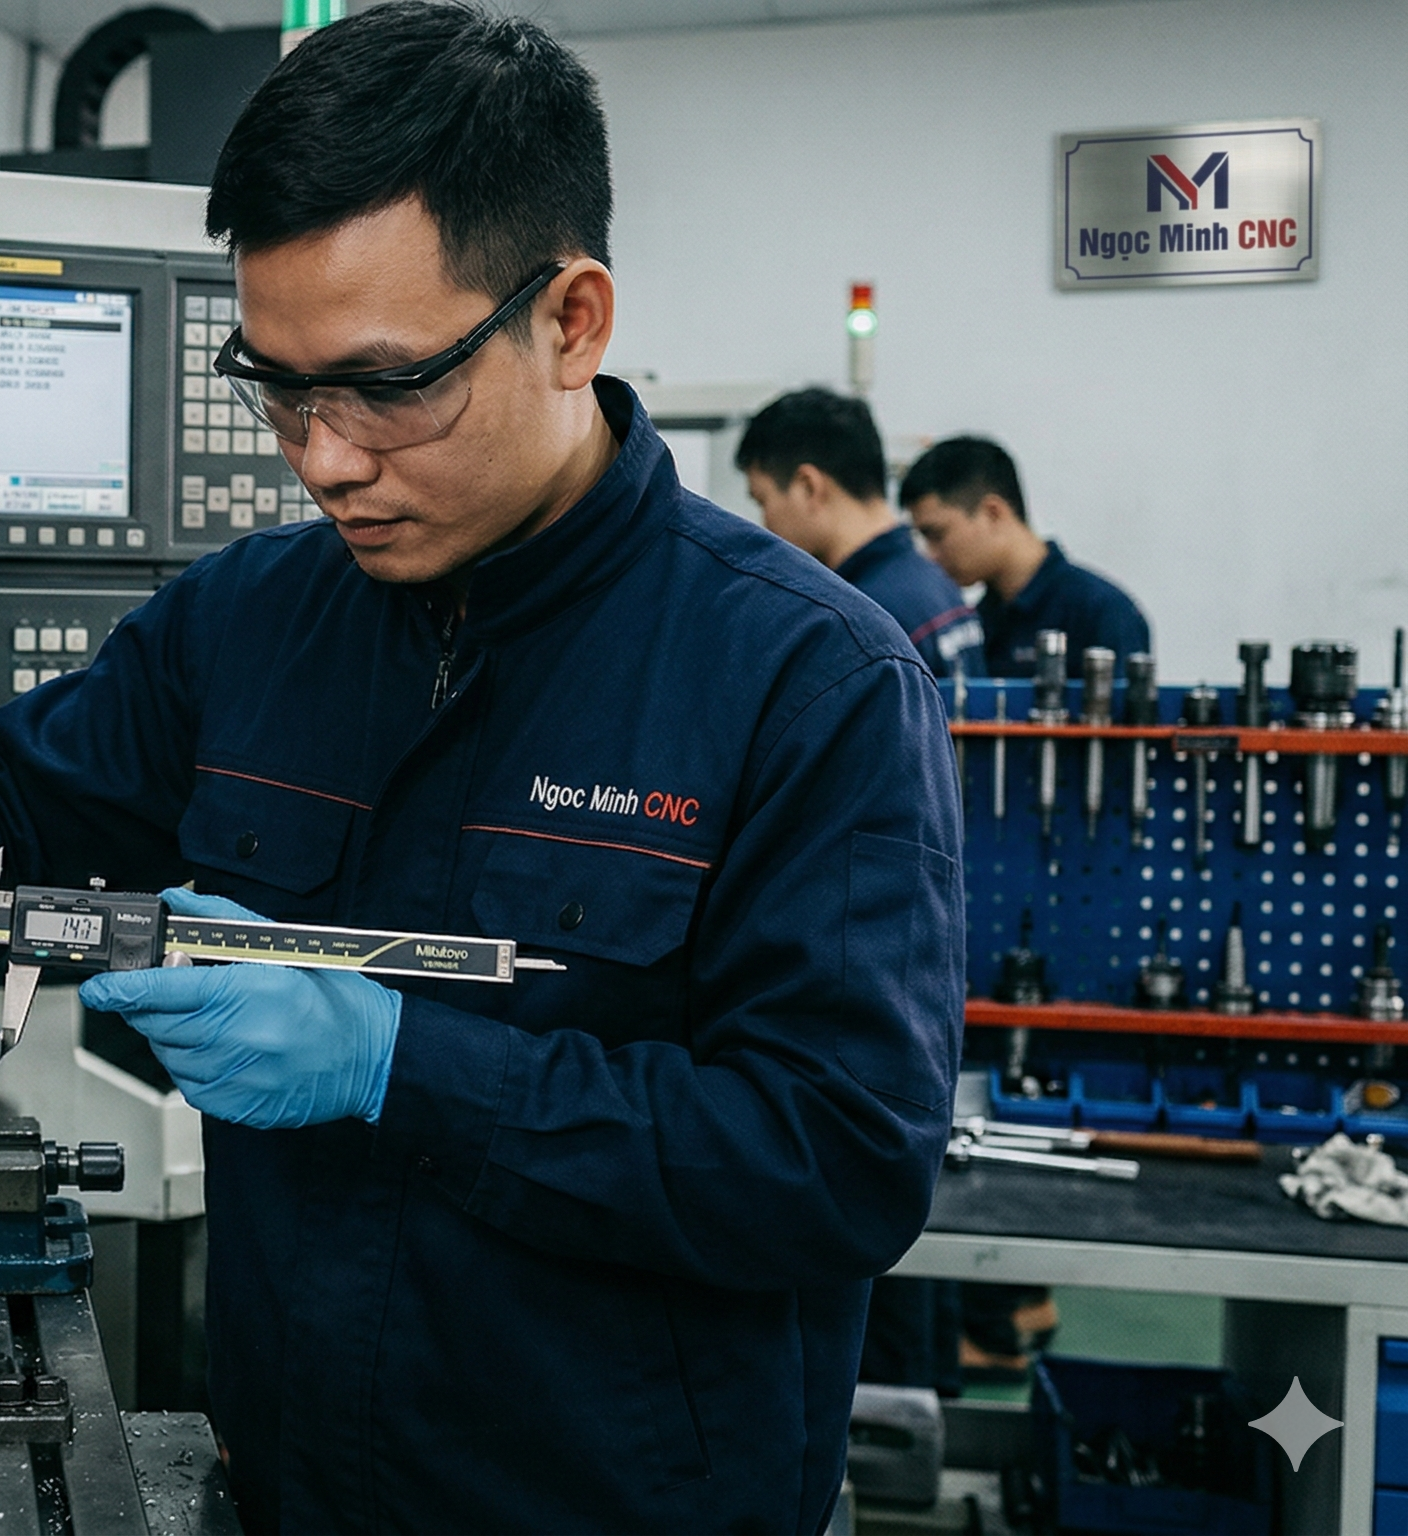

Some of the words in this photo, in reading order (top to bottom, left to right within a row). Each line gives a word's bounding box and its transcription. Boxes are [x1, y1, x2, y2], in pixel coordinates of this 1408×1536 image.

[1079, 227, 1150, 261] Ngọc
[1159, 222, 1228, 253] Minh
[1238, 218, 1297, 250] CNC
[530, 776, 585, 811] Ngoc
[644, 791, 699, 825] CNC
